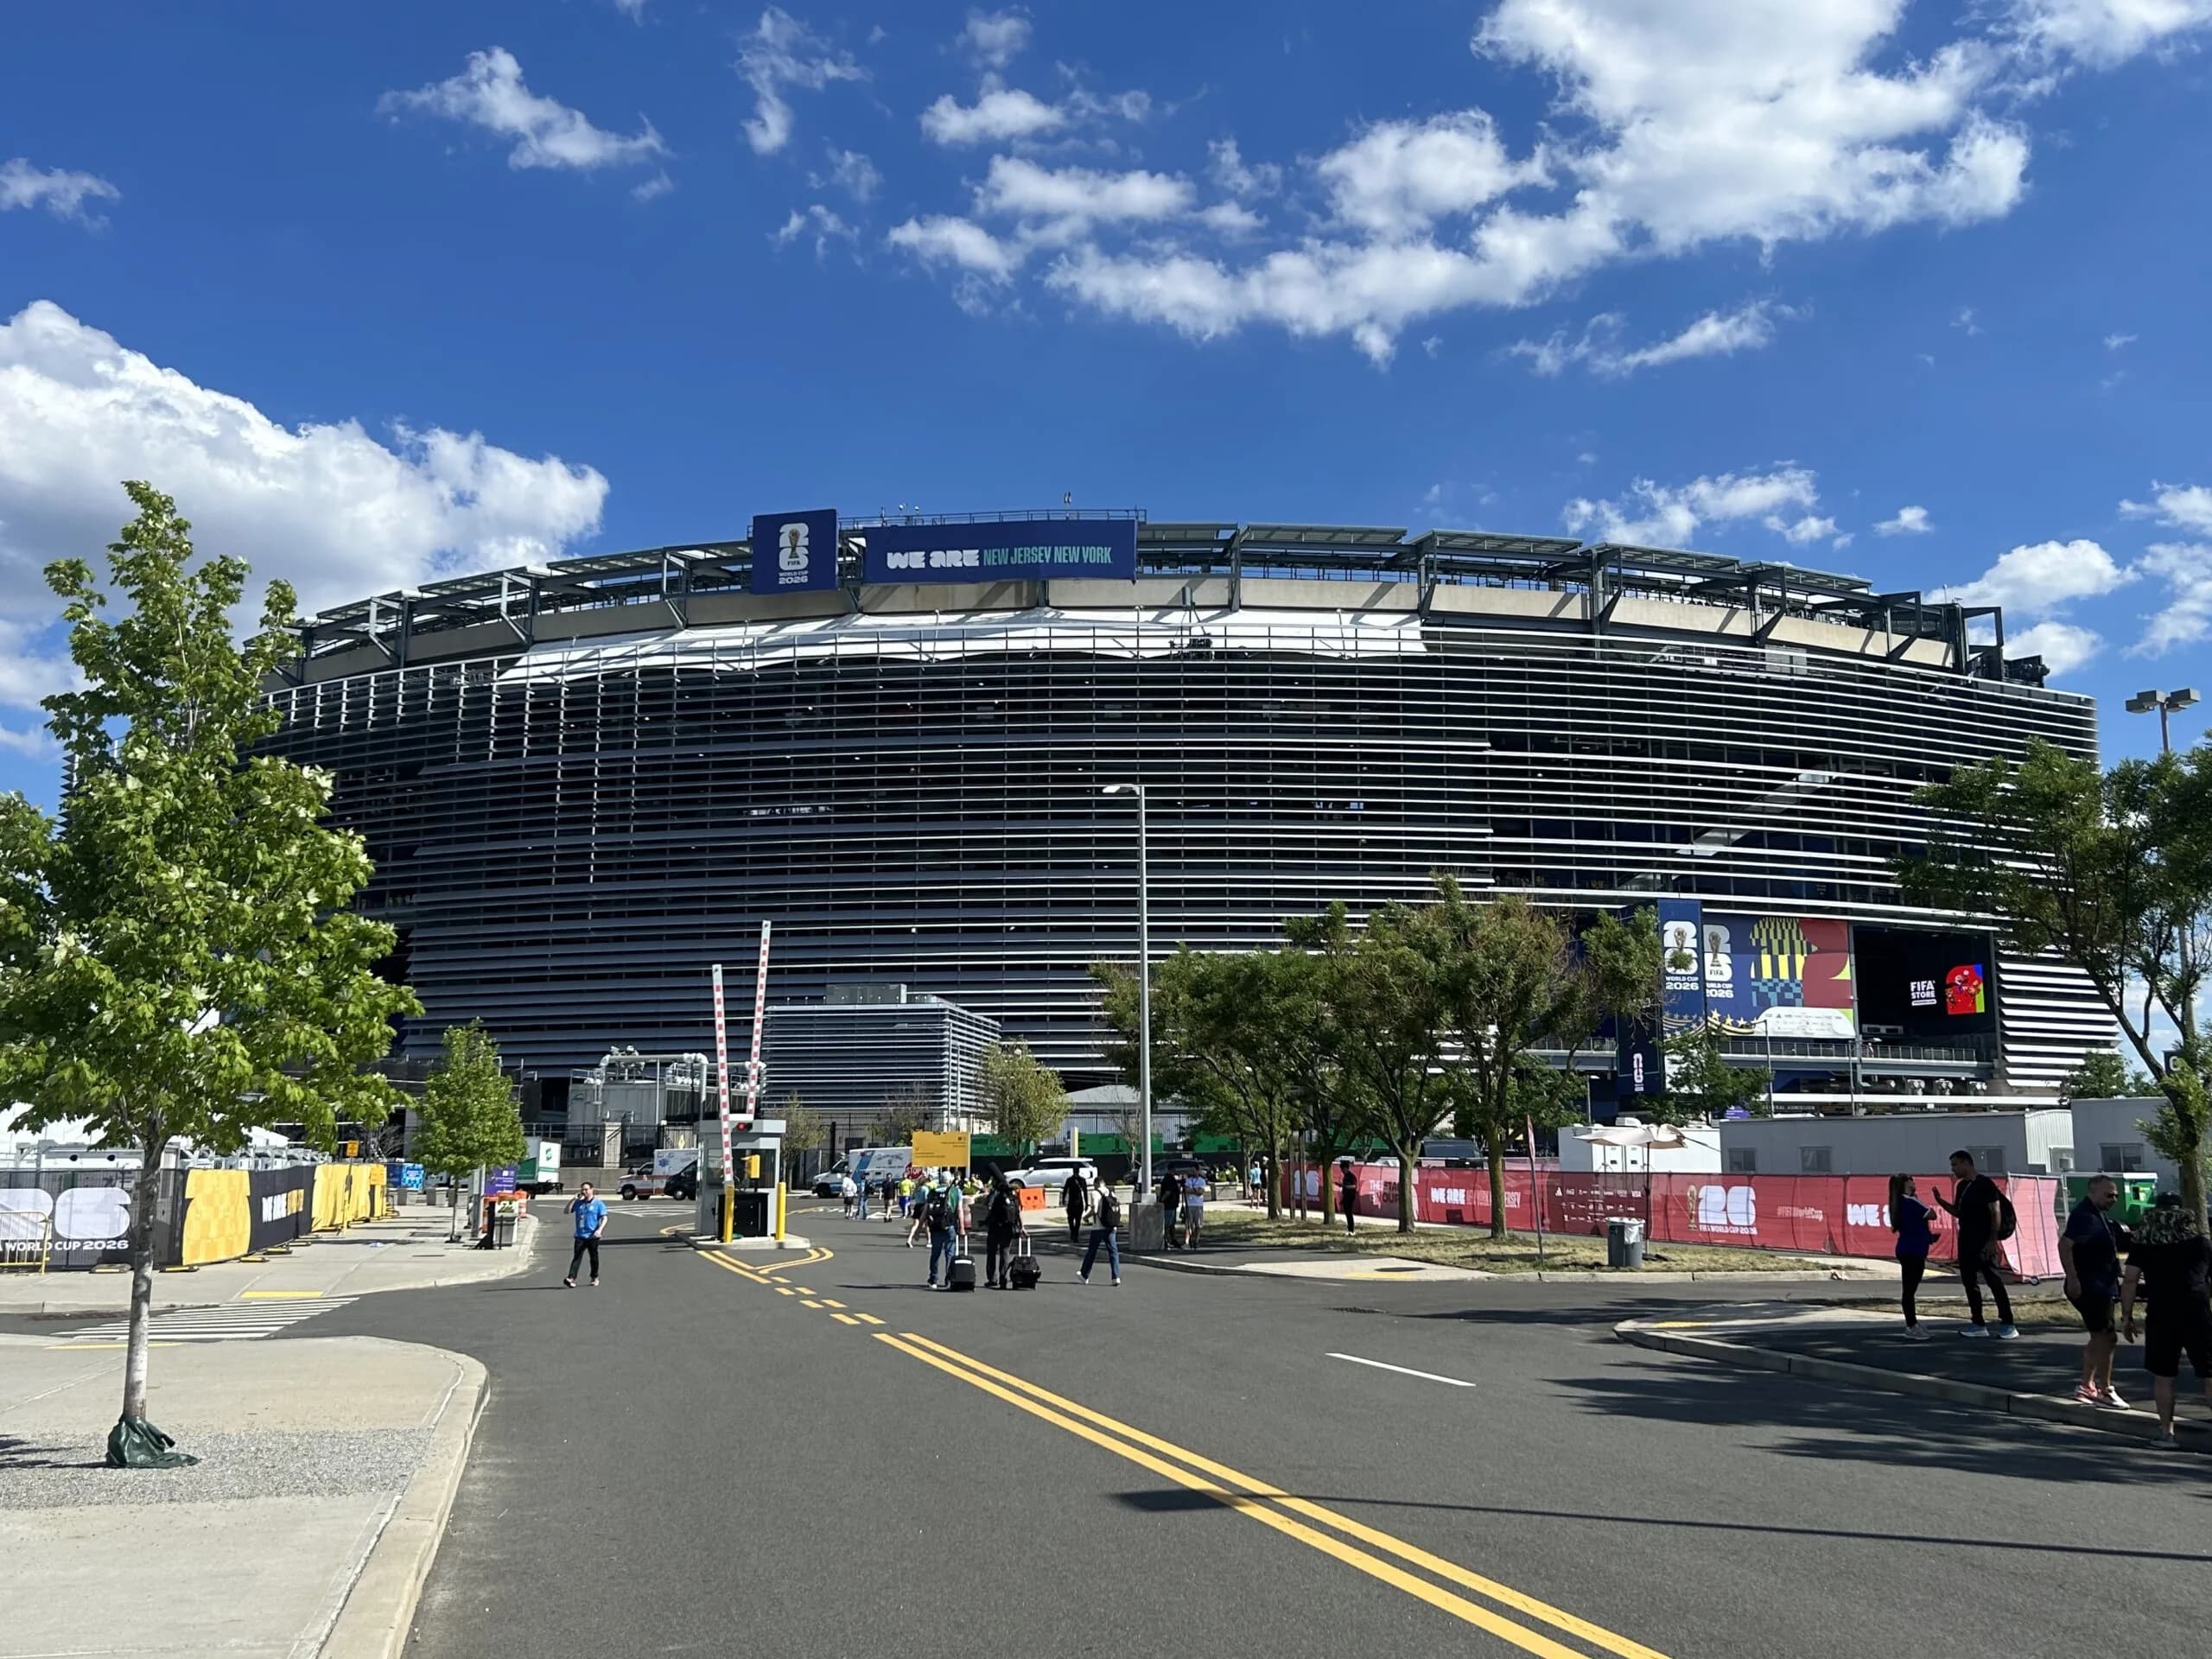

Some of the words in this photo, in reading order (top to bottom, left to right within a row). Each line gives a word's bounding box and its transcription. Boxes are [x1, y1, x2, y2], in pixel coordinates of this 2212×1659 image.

[887, 551, 925, 569] WE
[930, 549, 979, 568] ARE
[983, 548, 1008, 566] NEW
[1011, 546, 1052, 564] JERSEY
[1054, 546, 1080, 563] NEW
[1082, 546, 1112, 563] YORK
[779, 575, 809, 584] 2026
[1666, 982, 1700, 990] 2026
[1911, 990, 1936, 999] STORE
[1431, 1186, 1446, 1204] WE
[1446, 1188, 1465, 1205] ARE
[1699, 1185, 1756, 1226] 26
[1847, 1204, 1880, 1227] WE
[1711, 1224, 1728, 1233] WORLD
[1739, 1226, 1758, 1235] 2026
[5, 1240, 53, 1251] WORLD
[54, 1241, 81, 1250] CUP
[82, 1239, 129, 1250] 2026
